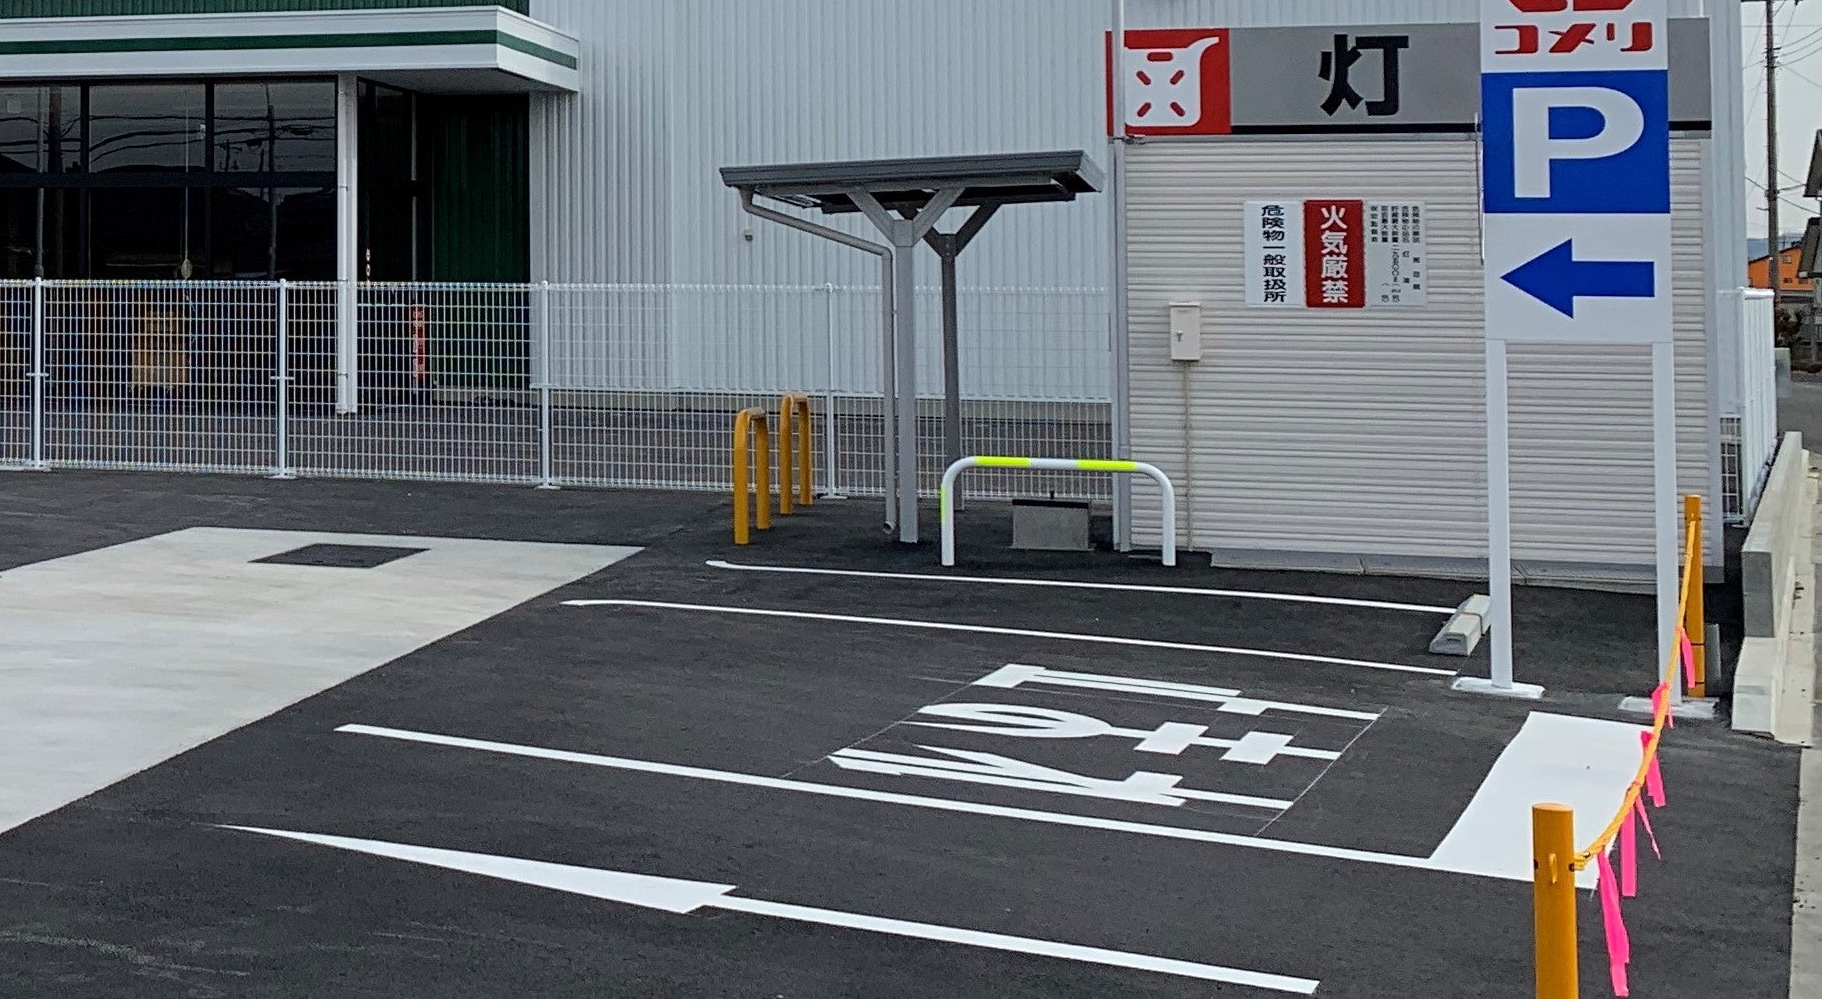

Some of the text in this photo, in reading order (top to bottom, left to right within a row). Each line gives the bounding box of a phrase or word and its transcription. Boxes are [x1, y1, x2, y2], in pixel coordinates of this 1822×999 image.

[1493, 21, 1654, 54] コメリ
[1513, 86, 1645, 198] P
[1261, 204, 1287, 303] 危険物一般取扱所
[1320, 204, 1349, 304] 火気厳禁
